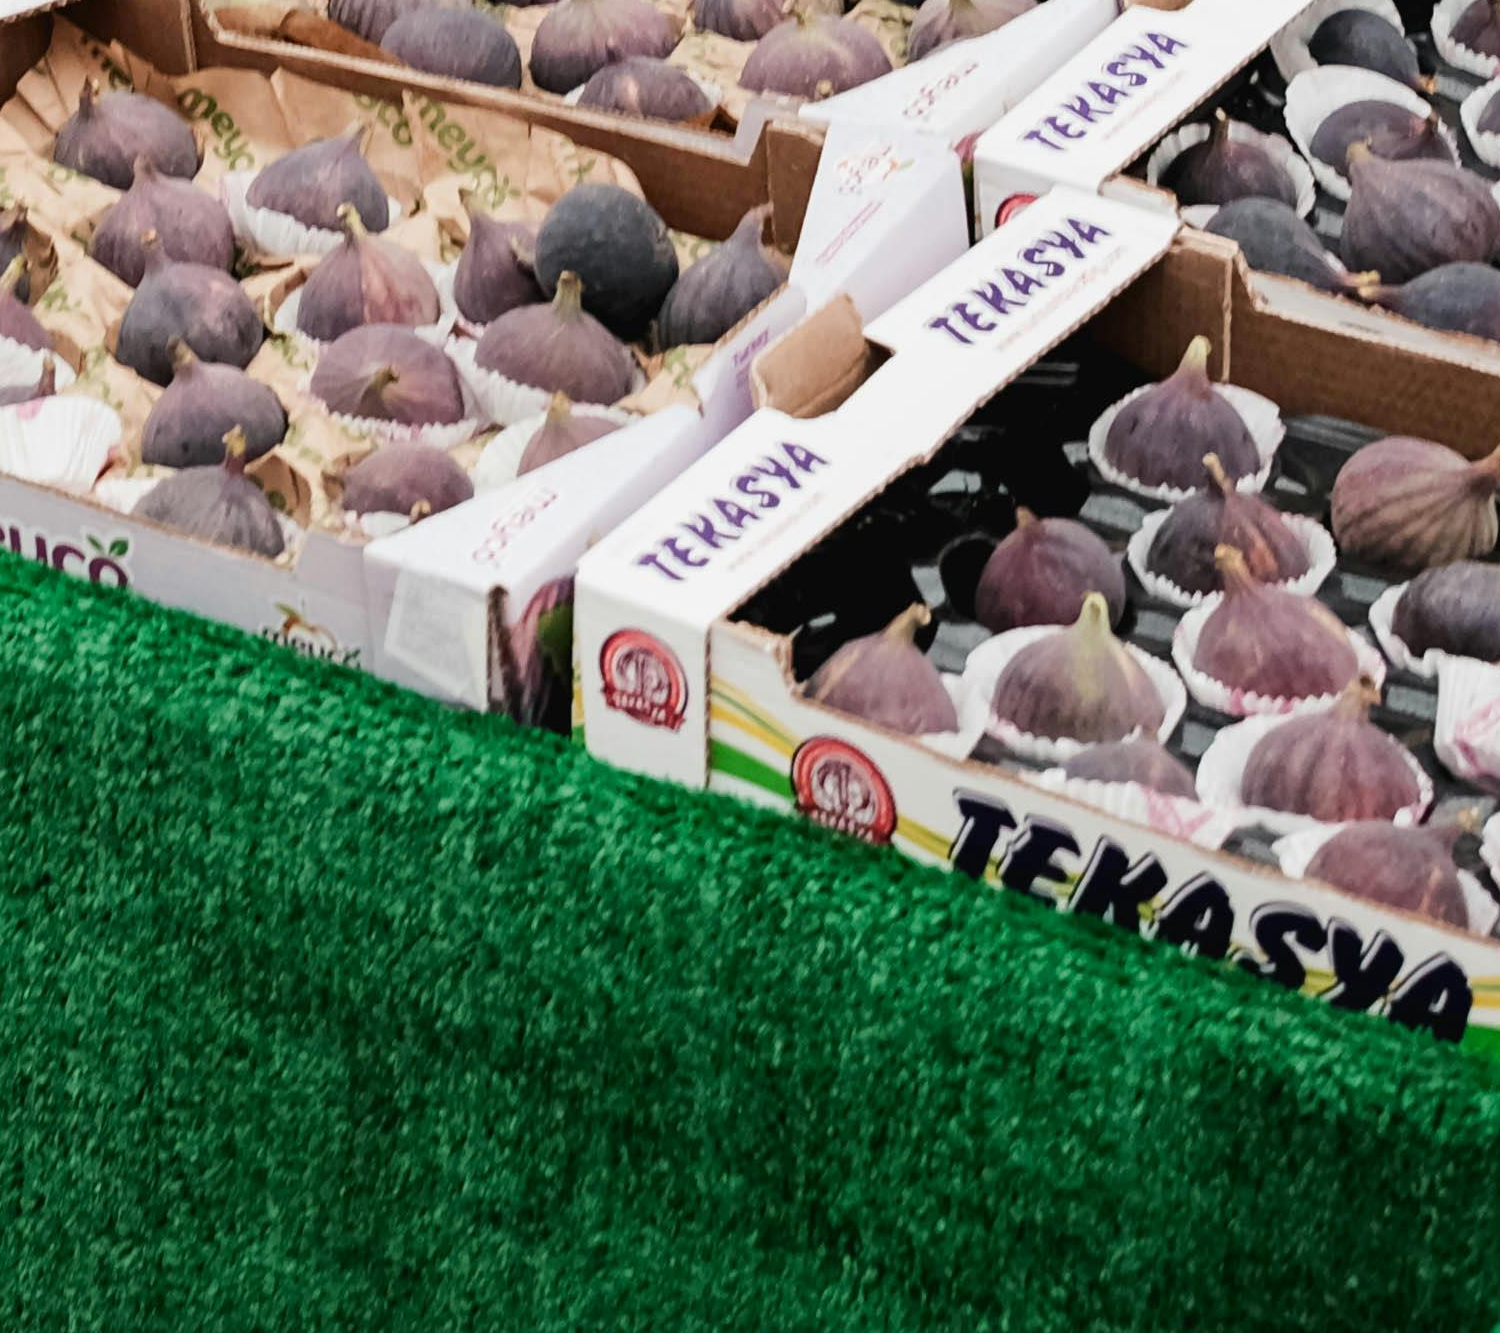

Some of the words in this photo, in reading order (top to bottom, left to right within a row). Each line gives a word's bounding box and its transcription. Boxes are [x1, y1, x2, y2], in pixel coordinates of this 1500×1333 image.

[1022, 31, 1190, 152] TEKASYA
[928, 217, 1110, 345] TEKASYA
[636, 441, 830, 581] TEKASYA
[947, 787, 1474, 1045] TEKASYA
